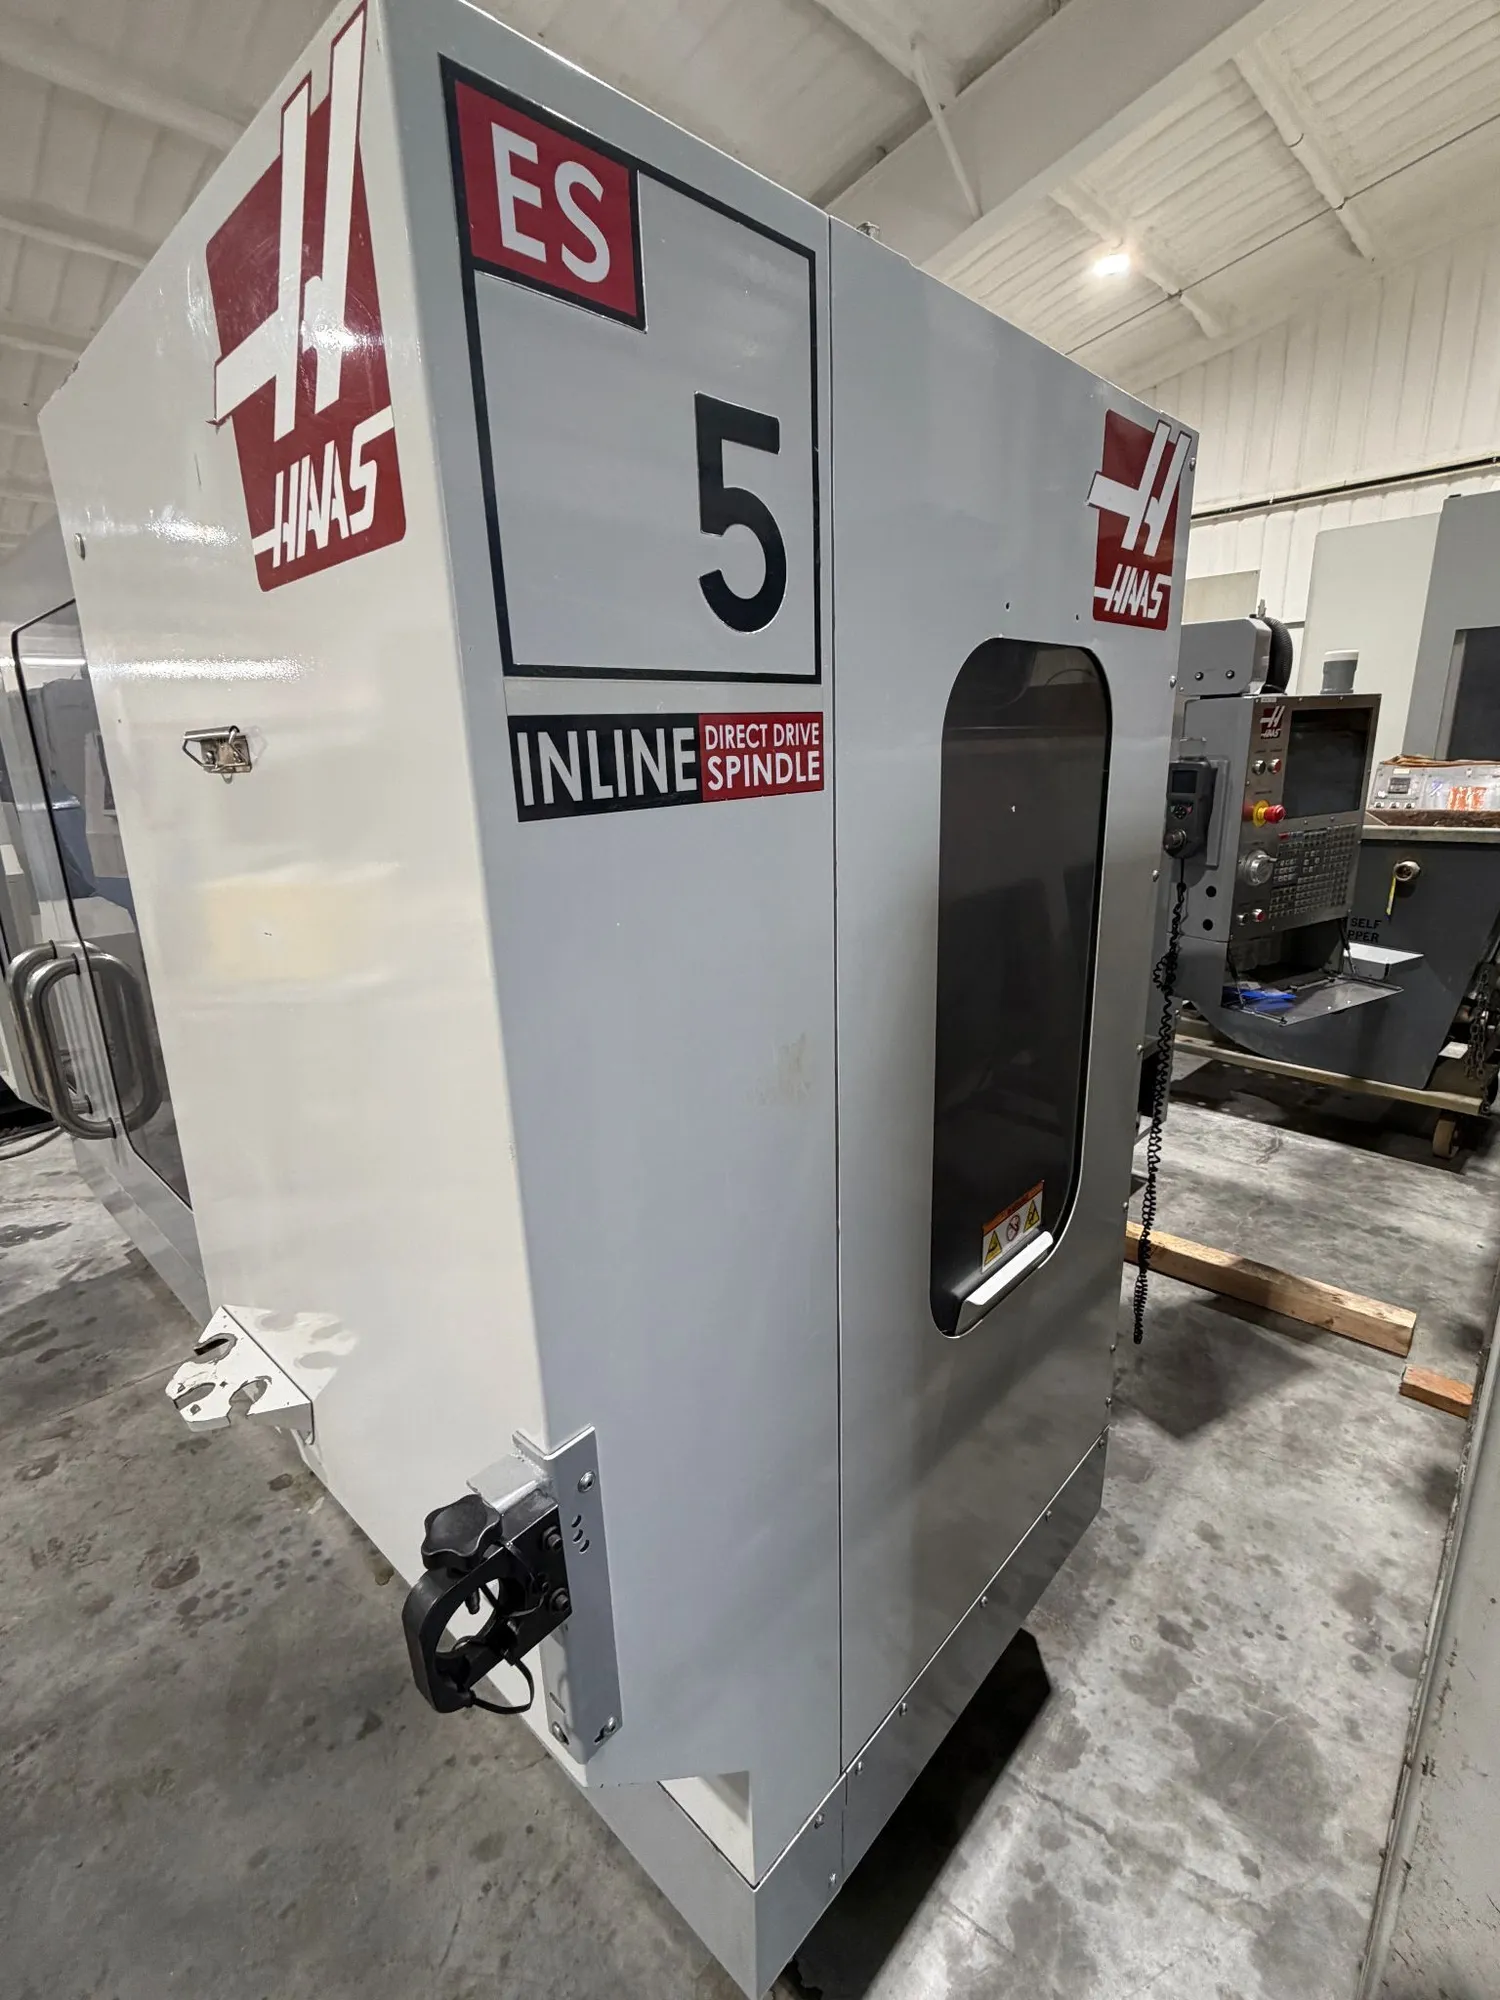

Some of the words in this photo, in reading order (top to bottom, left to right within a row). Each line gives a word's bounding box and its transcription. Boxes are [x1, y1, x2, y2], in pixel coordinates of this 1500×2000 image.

[490, 121, 612, 284] ES
[252, 405, 395, 568] HAAS
[694, 390, 788, 635] 5
[1093, 563, 1173, 619] HAAS
[704, 723, 768, 750] DIRECT
[773, 722, 820, 747] DRIVE
[516, 726, 698, 807] INLINE
[707, 750, 820, 791] SPINDLE
[1347, 929, 1380, 943] PPER
[1350, 917, 1382, 929] SELF
